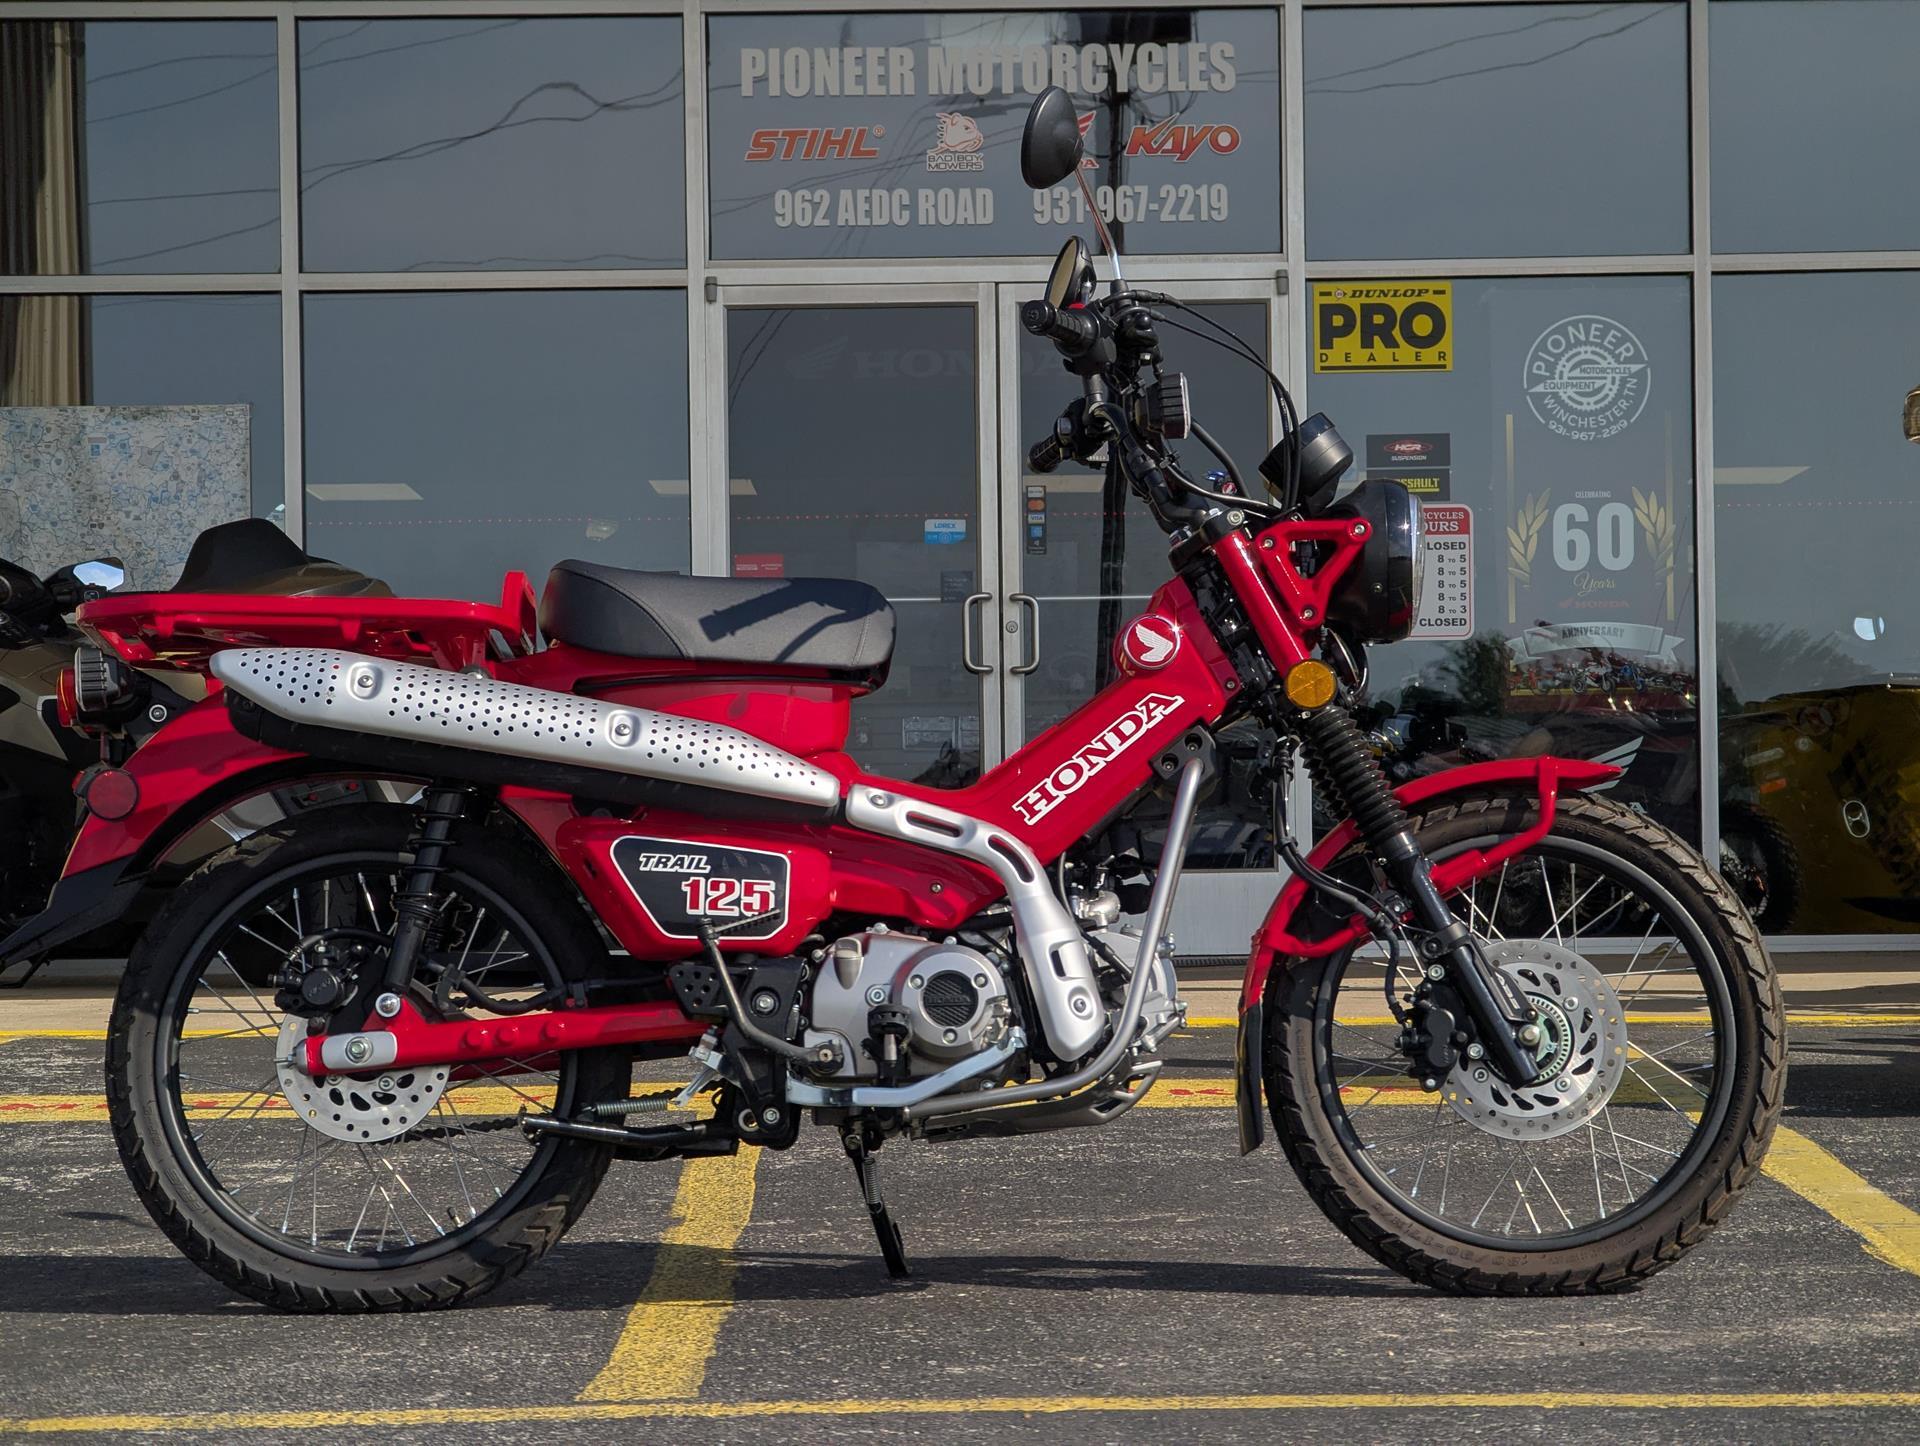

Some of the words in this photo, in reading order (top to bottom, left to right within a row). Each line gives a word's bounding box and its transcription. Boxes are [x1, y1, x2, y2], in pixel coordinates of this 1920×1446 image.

[741, 46, 915, 97] PIONEER
[928, 42, 1237, 95] MOTORCYCLES
[1125, 112, 1241, 162] KAYO
[745, 127, 880, 161] STIHL
[928, 154, 954, 163] BAD
[957, 154, 983, 163] BOY
[928, 162, 983, 170] MOWERS
[774, 190, 831, 227] 962
[837, 188, 910, 226] AEDC
[918, 187, 994, 226] ROAD
[1349, 288, 1430, 298] DUNLOP
[1319, 301, 1446, 350] PRO
[1532, 322, 1635, 376] PIONEER
[1319, 351, 1447, 363] DEALER
[1581, 366, 1631, 374] MOTORCYCLES
[1543, 381, 1596, 390] EQUIPMENT
[1623, 377, 1638, 396] TN
[1548, 419, 1628, 441] 931-967-2219
[1400, 477, 1440, 488] SSAULT
[1552, 502, 1635, 572] 60
[1426, 541, 1466, 550] LOSED
[1437, 555, 1444, 563] 8
[1460, 555, 1467, 563] 5
[1437, 568, 1444, 576] 8
[1460, 568, 1467, 576] 5
[1437, 580, 1444, 588] 8
[1460, 580, 1467, 588] 5
[1573, 571, 1616, 597] Years
[1437, 593, 1444, 601] 8
[1460, 593, 1467, 601] 5
[1438, 606, 1445, 614] 8
[1460, 606, 1467, 614] 3
[1419, 617, 1467, 627] CLOSED
[1561, 625, 1625, 639] ANNIVERSARY
[1012, 693, 1185, 826] HONDA
[639, 853, 711, 873] TRAIL
[681, 877, 776, 917] 125
